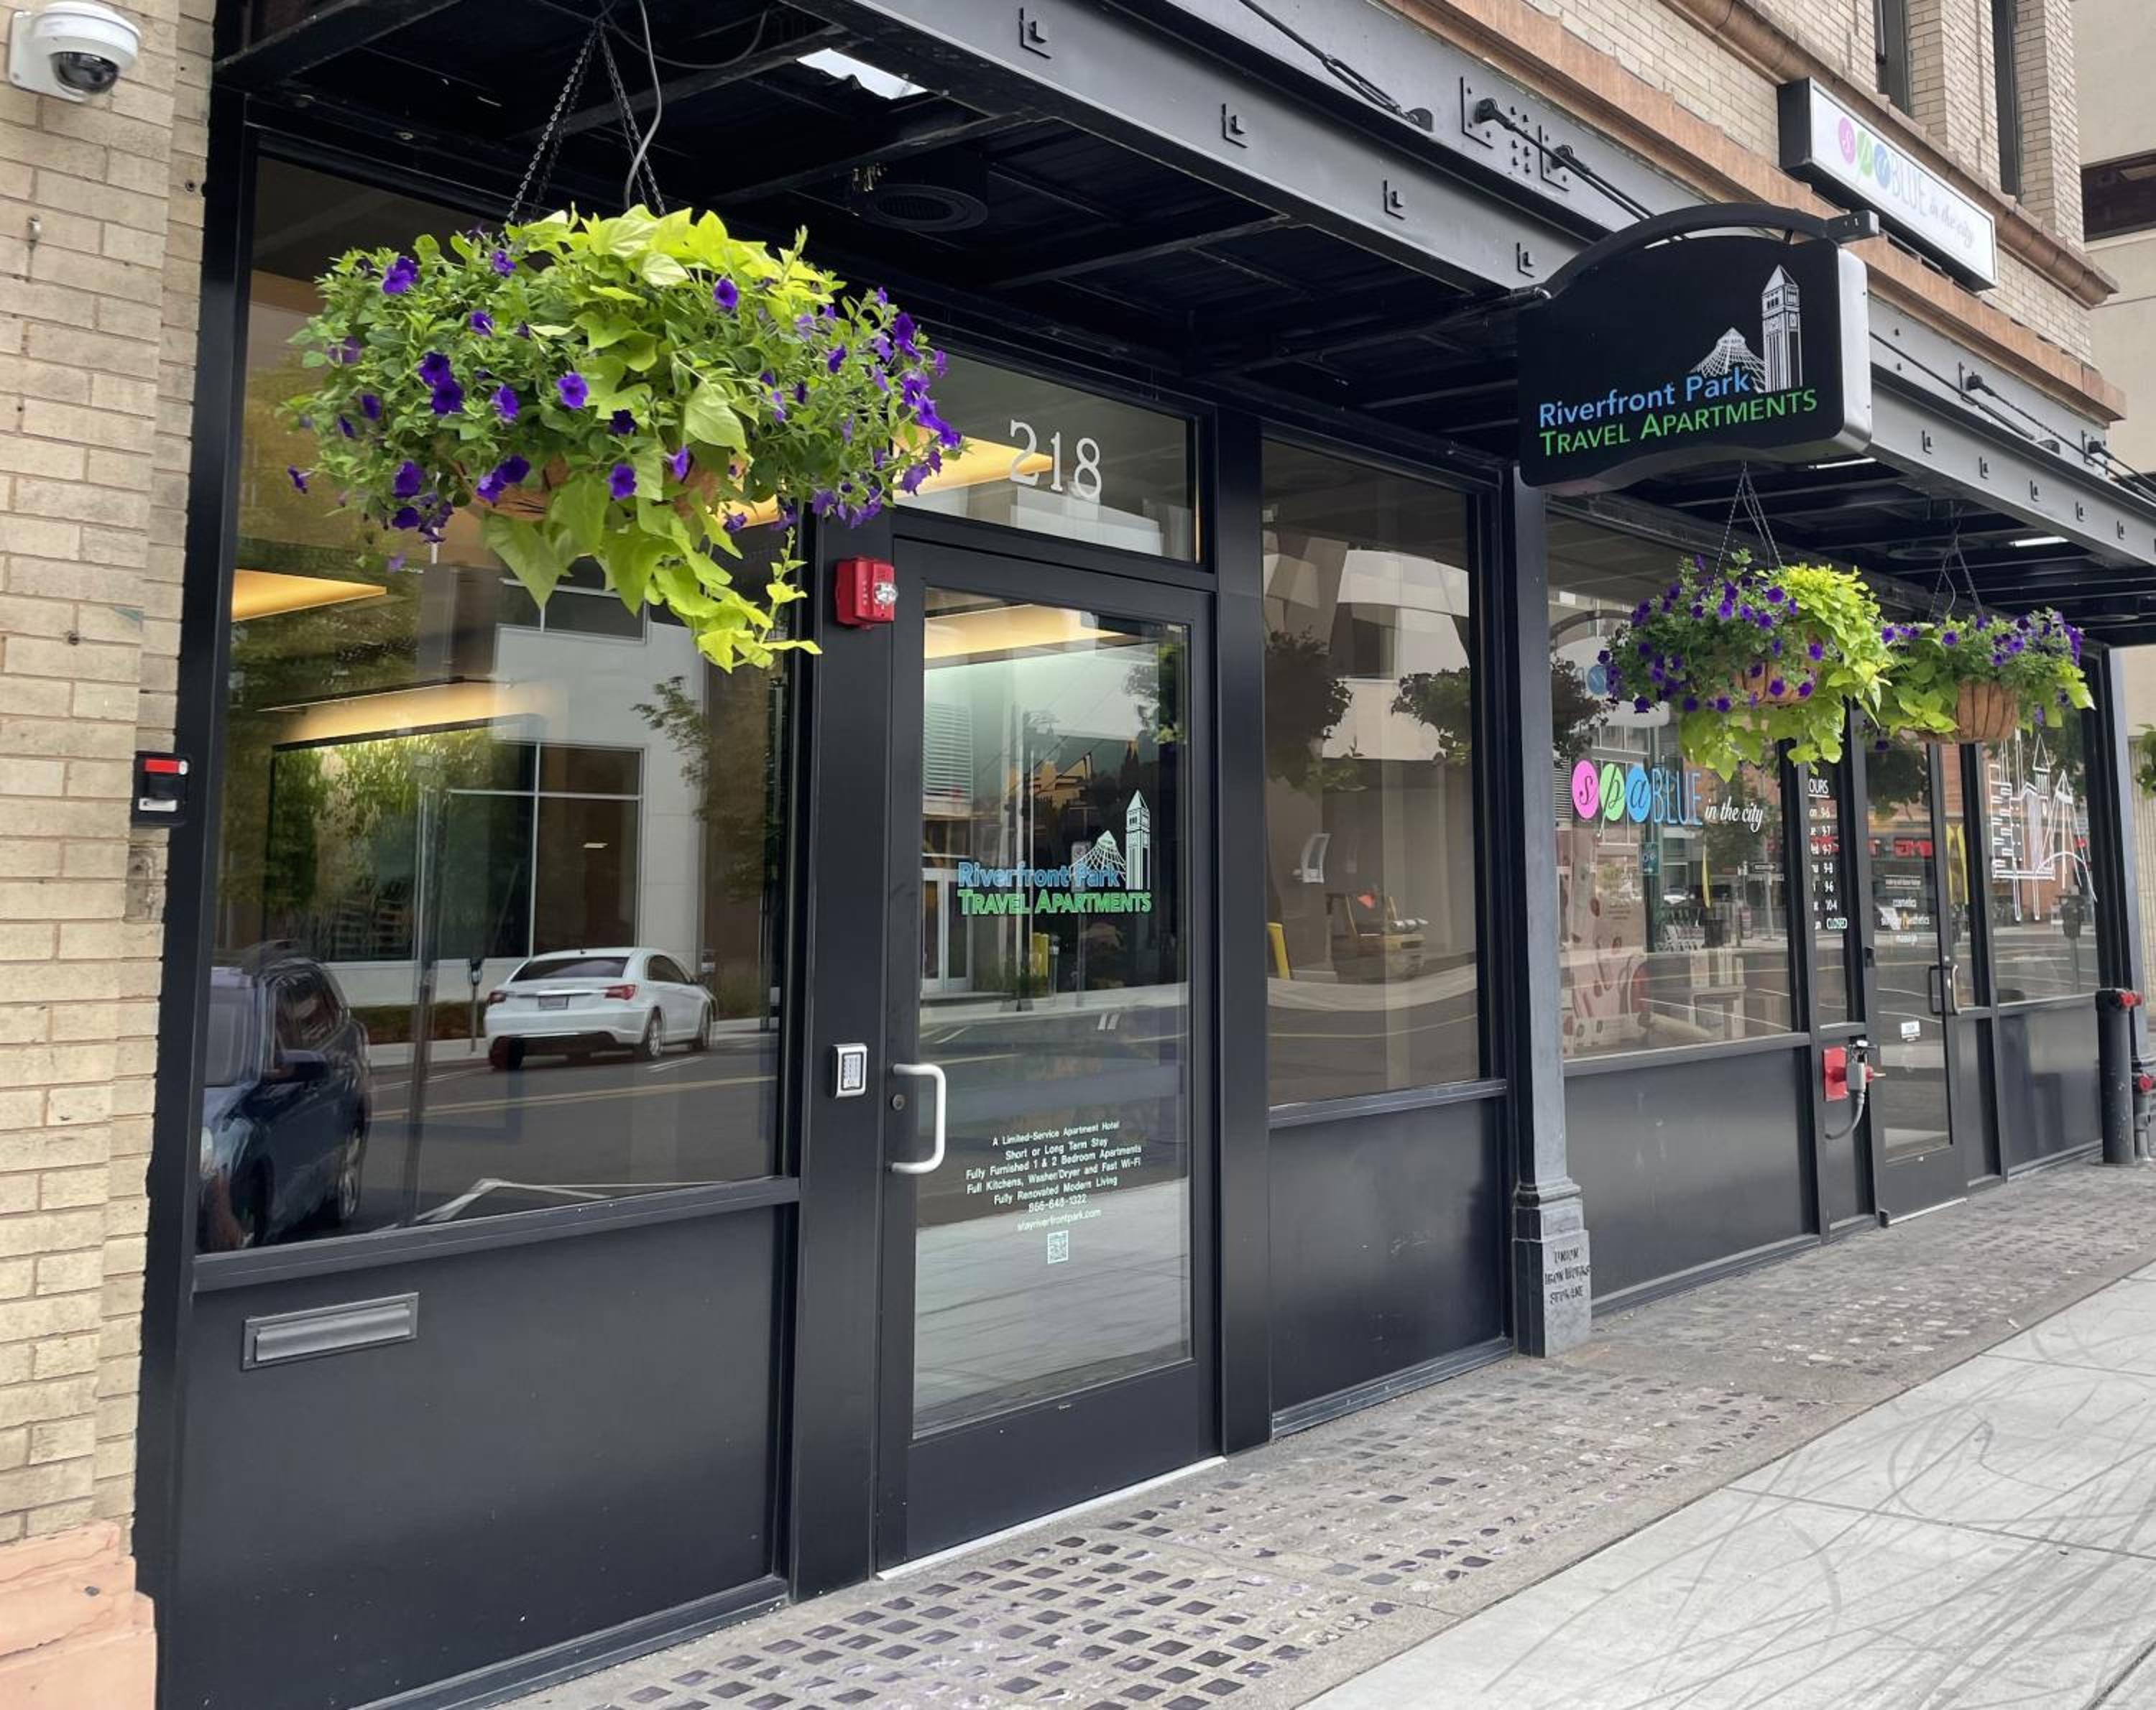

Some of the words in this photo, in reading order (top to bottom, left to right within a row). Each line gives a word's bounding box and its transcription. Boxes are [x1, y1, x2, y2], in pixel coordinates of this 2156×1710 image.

[1540, 383, 1674, 428] Riverfront
[1686, 366, 1751, 401] Park
[1539, 424, 1630, 456] TRAVEL
[1641, 389, 1818, 440] APARTMENTS
[1010, 419, 1102, 498] 218
[1652, 767, 1703, 826] BLUE
[1705, 798, 1717, 819] in
[1720, 795, 1739, 821] the
[1742, 803, 1763, 832] city
[1809, 778, 1829, 794] OURS
[958, 861, 1070, 887] Riverfront
[1077, 862, 1120, 887] Park
[957, 889, 1030, 915] TRAVEL
[1035, 889, 1151, 914] APARTMENTS
[992, 1137, 998, 1146] A
[1002, 1129, 1059, 1145] Limited-Service
[1064, 1123, 1098, 1137] Apartment
[1102, 1120, 1120, 1132] Hotel
[1005, 1147, 1027, 1160] Short
[1031, 1147, 1041, 1156] or
[1044, 1145, 1064, 1155] Long
[1068, 1141, 1087, 1151] Term
[1091, 1137, 1108, 1148] Stay
[966, 1168, 985, 1180] Fully
[990, 1160, 1030, 1176] Furnished
[1033, 1159, 1038, 1169] 1
[1041, 1157, 1047, 1168] &
[1051, 1156, 1057, 1166] 2
[1061, 1152, 1095, 1164] Bedroom
[1099, 1144, 1142, 1160] Apartments
[967, 1182, 983, 1194] Full
[1084, 1163, 1098, 1175] and
[1102, 1160, 1118, 1172] Fast
[994, 1193, 1013, 1205] Fully
[1017, 1184, 1059, 1201] Renovated
[1064, 1180, 1092, 1193] Modern
[1096, 1175, 1118, 1188] Living
